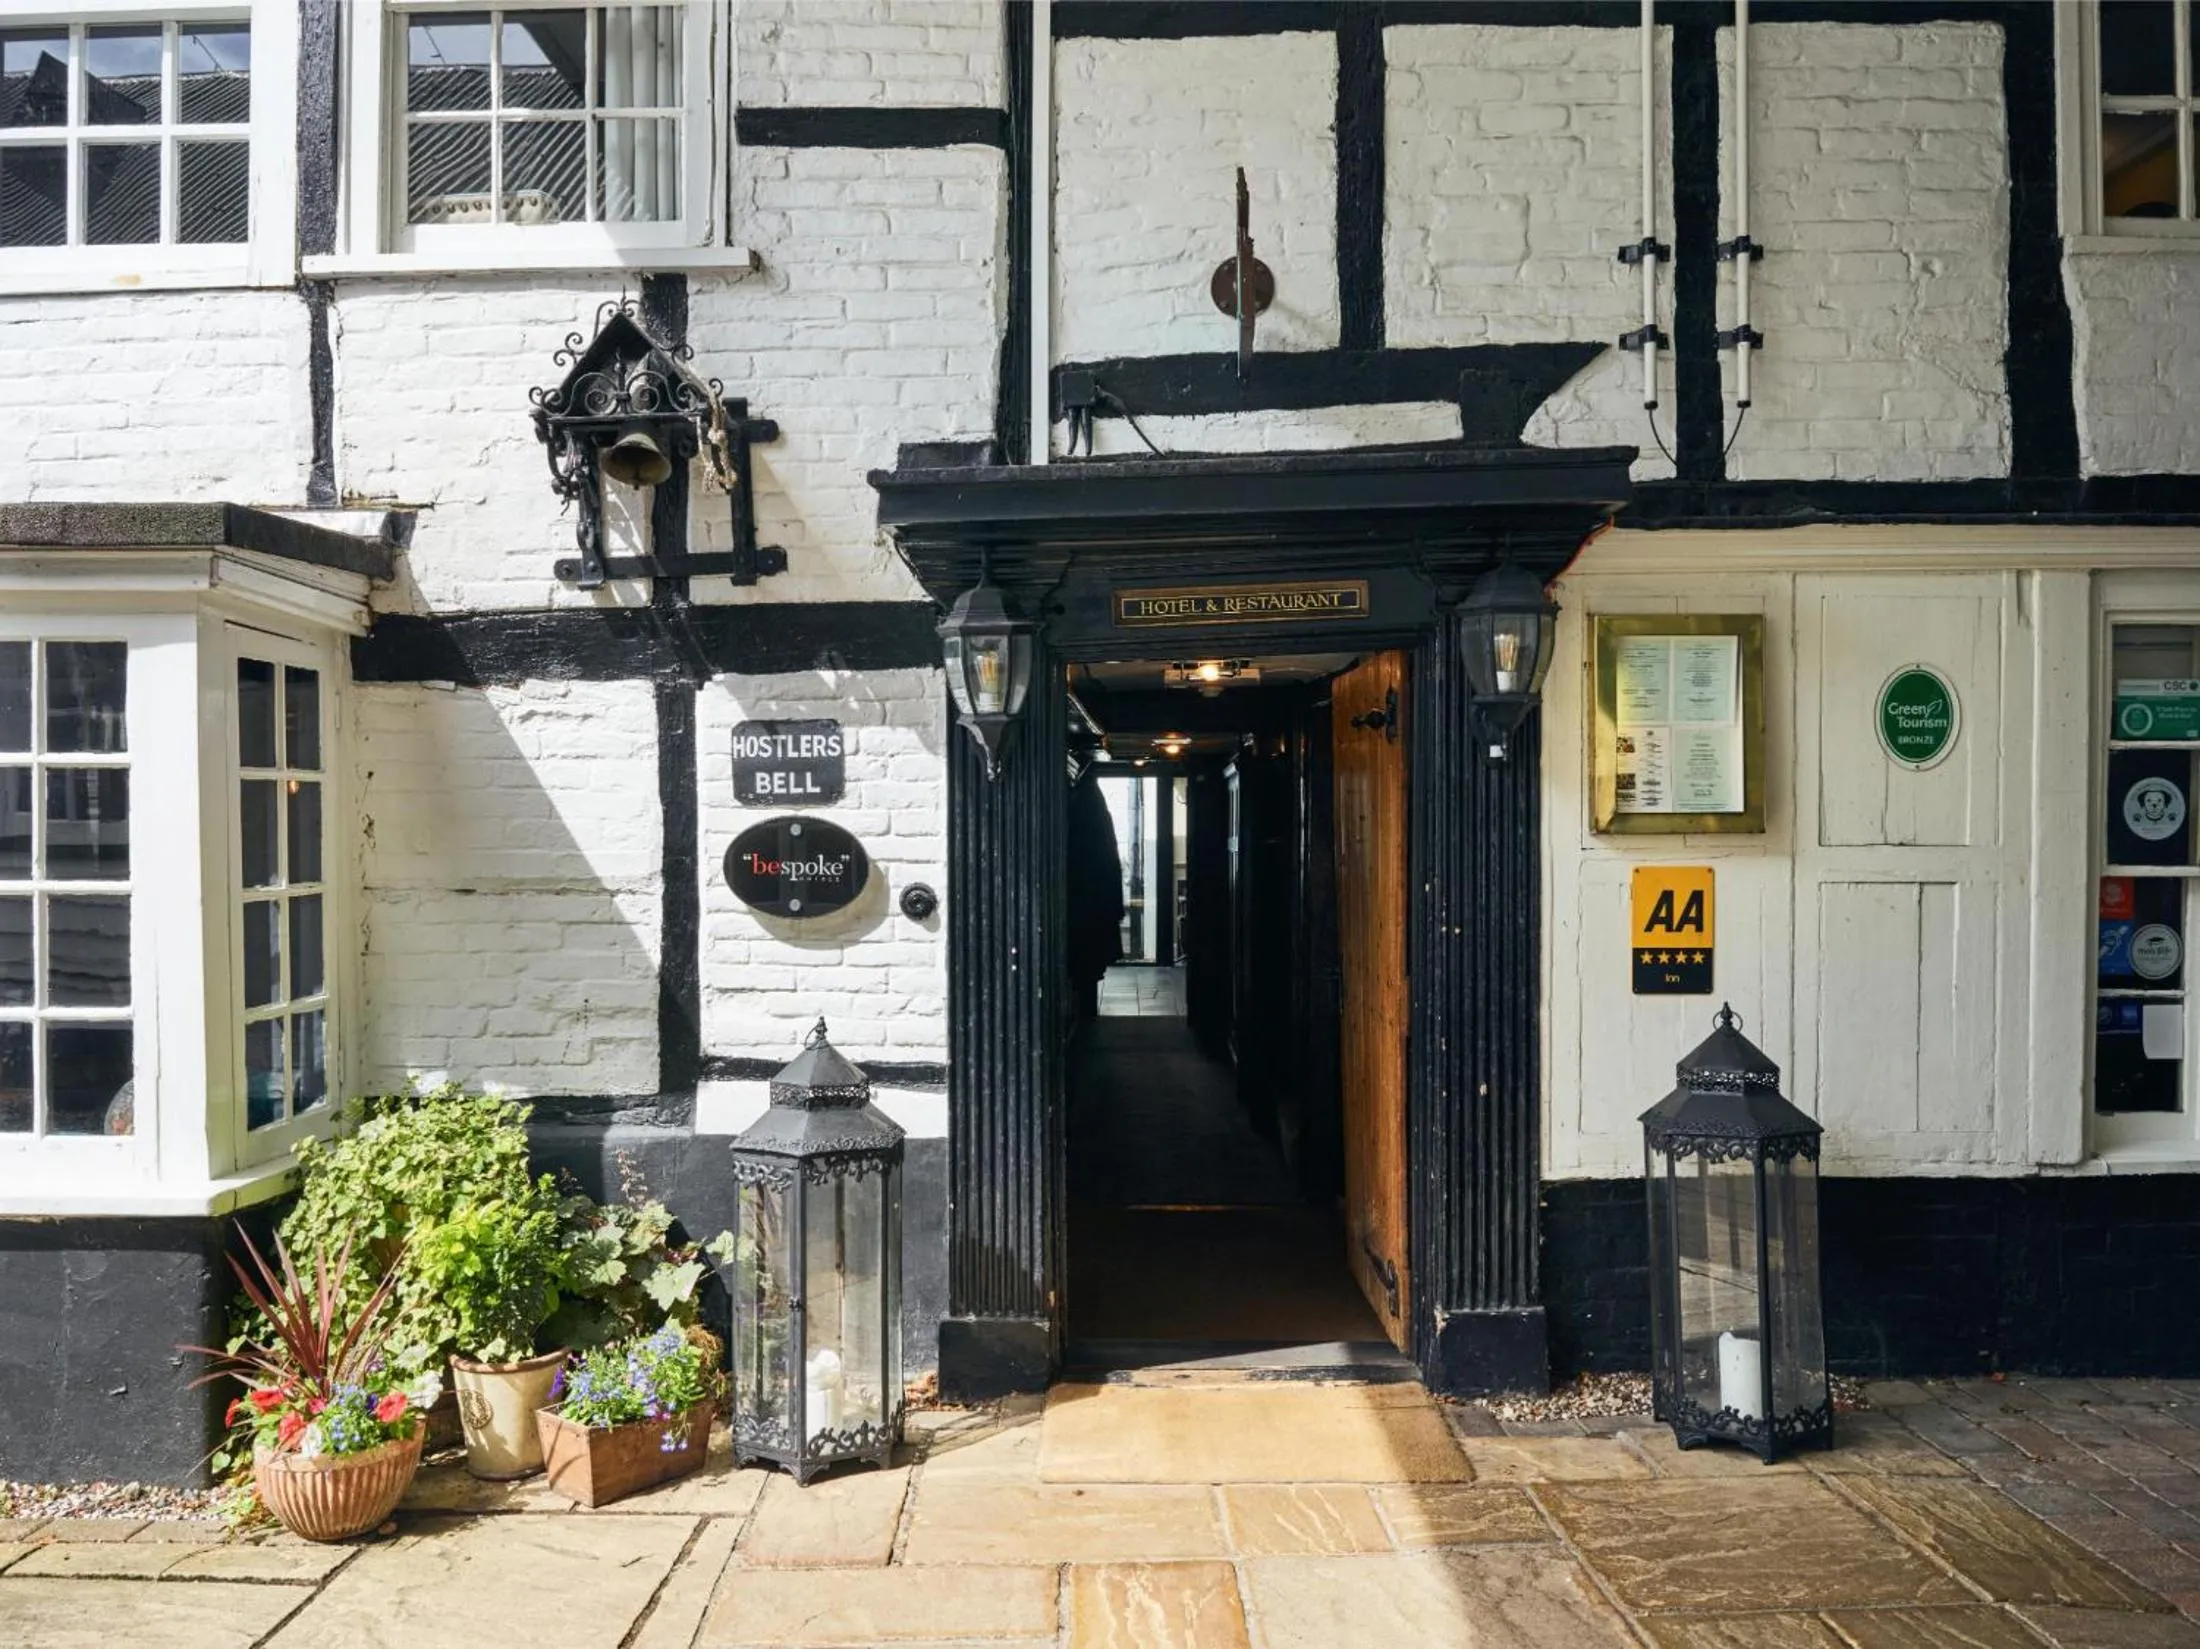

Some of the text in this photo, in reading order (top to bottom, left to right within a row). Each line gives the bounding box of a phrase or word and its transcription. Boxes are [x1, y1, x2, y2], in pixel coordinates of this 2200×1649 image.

[1140, 593, 1342, 615] HOTEL & RESTAURANT
[1888, 702, 1926, 715] Green
[1898, 716, 1947, 728] Tourism
[732, 735, 841, 759] HOSTLERS
[1897, 735, 1934, 745] BRONZE
[755, 772, 821, 794] BELL
[1643, 889, 1704, 933] AA
